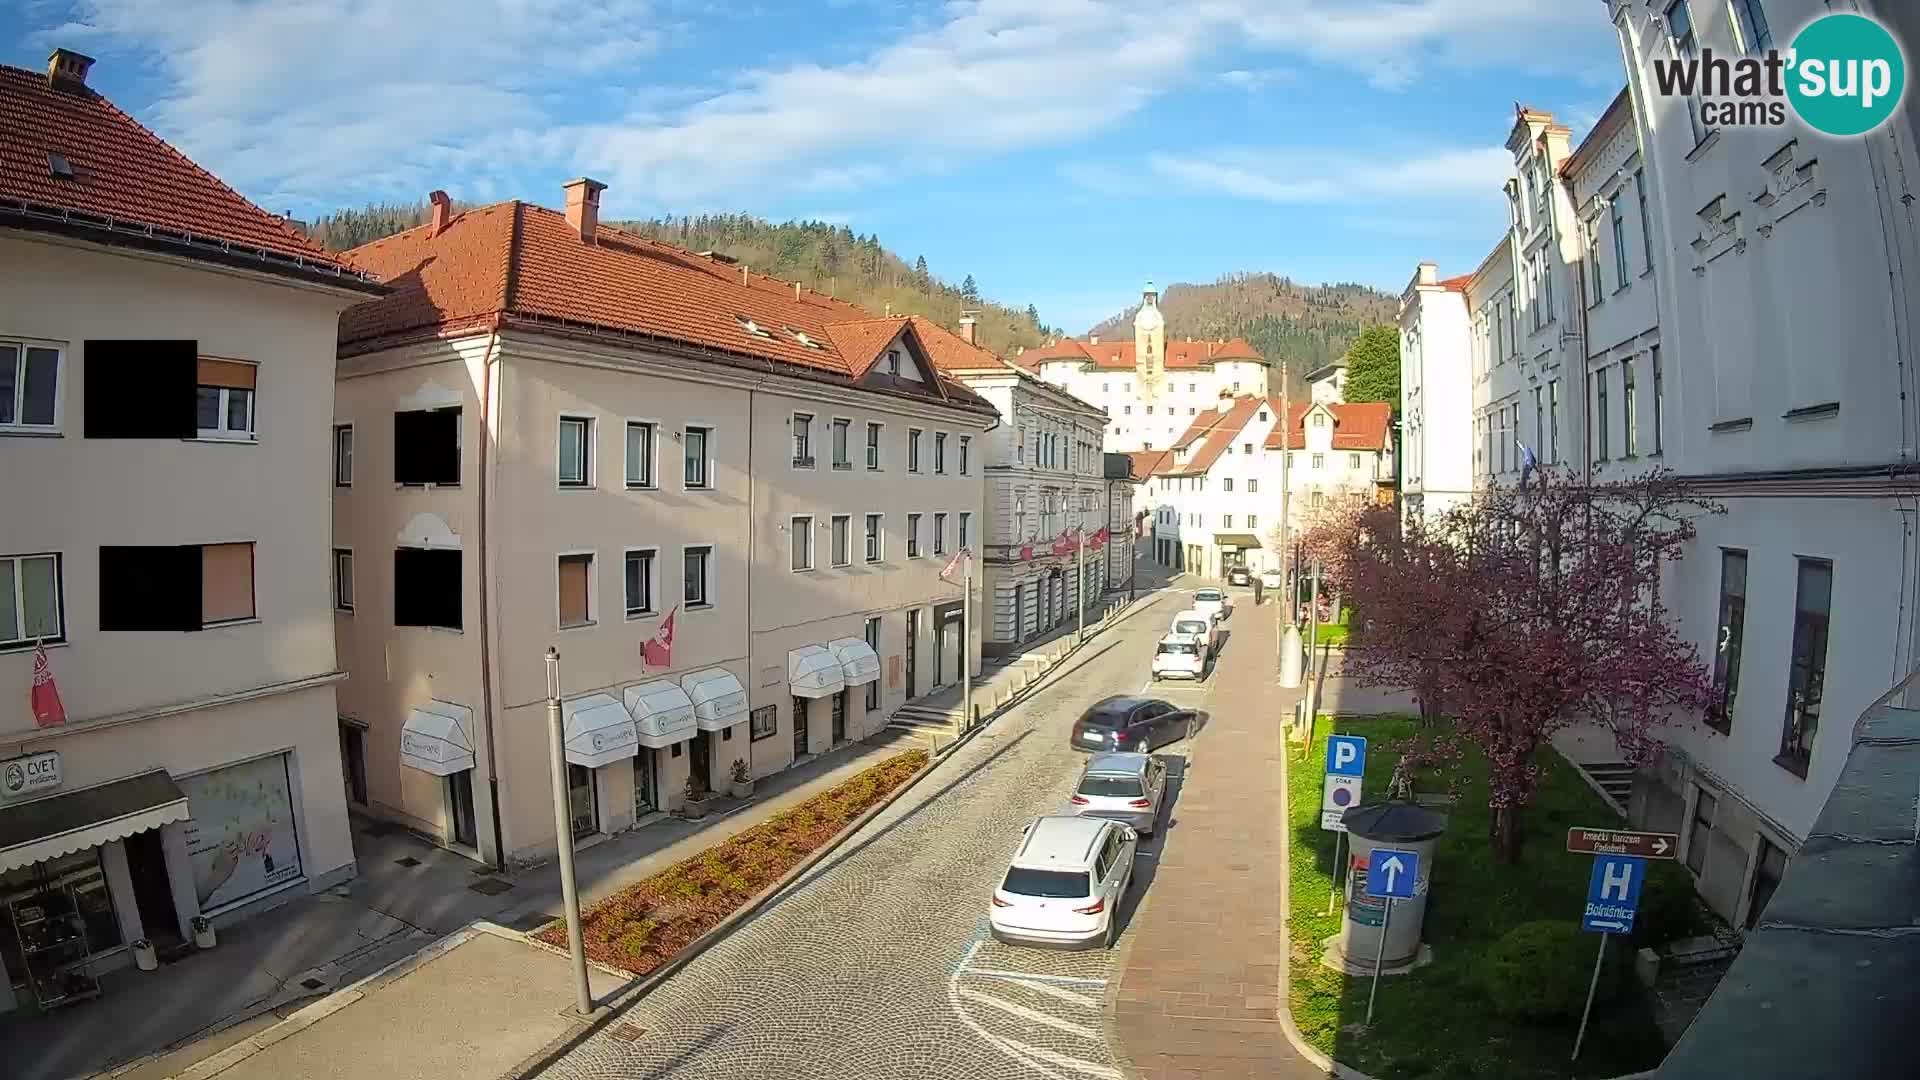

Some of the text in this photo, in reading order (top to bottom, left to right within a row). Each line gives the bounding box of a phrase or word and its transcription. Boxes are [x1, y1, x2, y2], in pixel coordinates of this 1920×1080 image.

[27, 758, 55, 775] CVET
[1335, 741, 1356, 769] P
[1601, 862, 1632, 901] H
[1584, 902, 1634, 920] Bolnišnica
